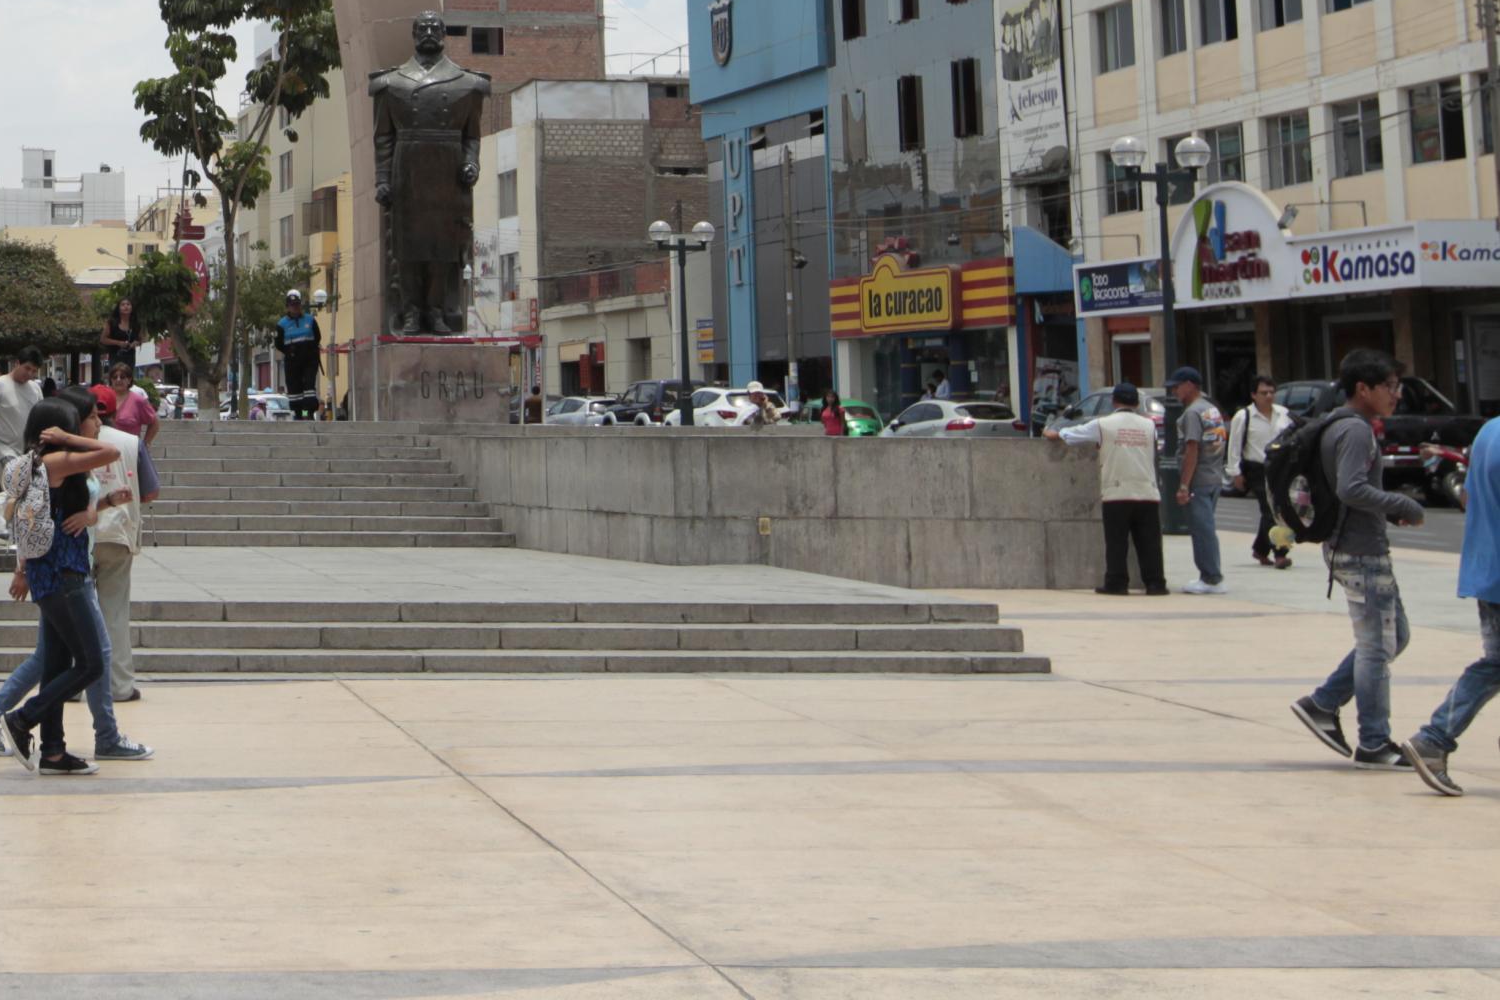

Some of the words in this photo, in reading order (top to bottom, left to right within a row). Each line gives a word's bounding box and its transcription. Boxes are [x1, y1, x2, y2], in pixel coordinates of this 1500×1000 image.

[1018, 87, 1058, 112] telesup
[1224, 230, 1261, 253] san
[1322, 245, 1415, 283] Kamasa
[868, 289, 882, 318] la
[885, 286, 943, 317] curacao
[420, 369, 484, 400] GRAU
